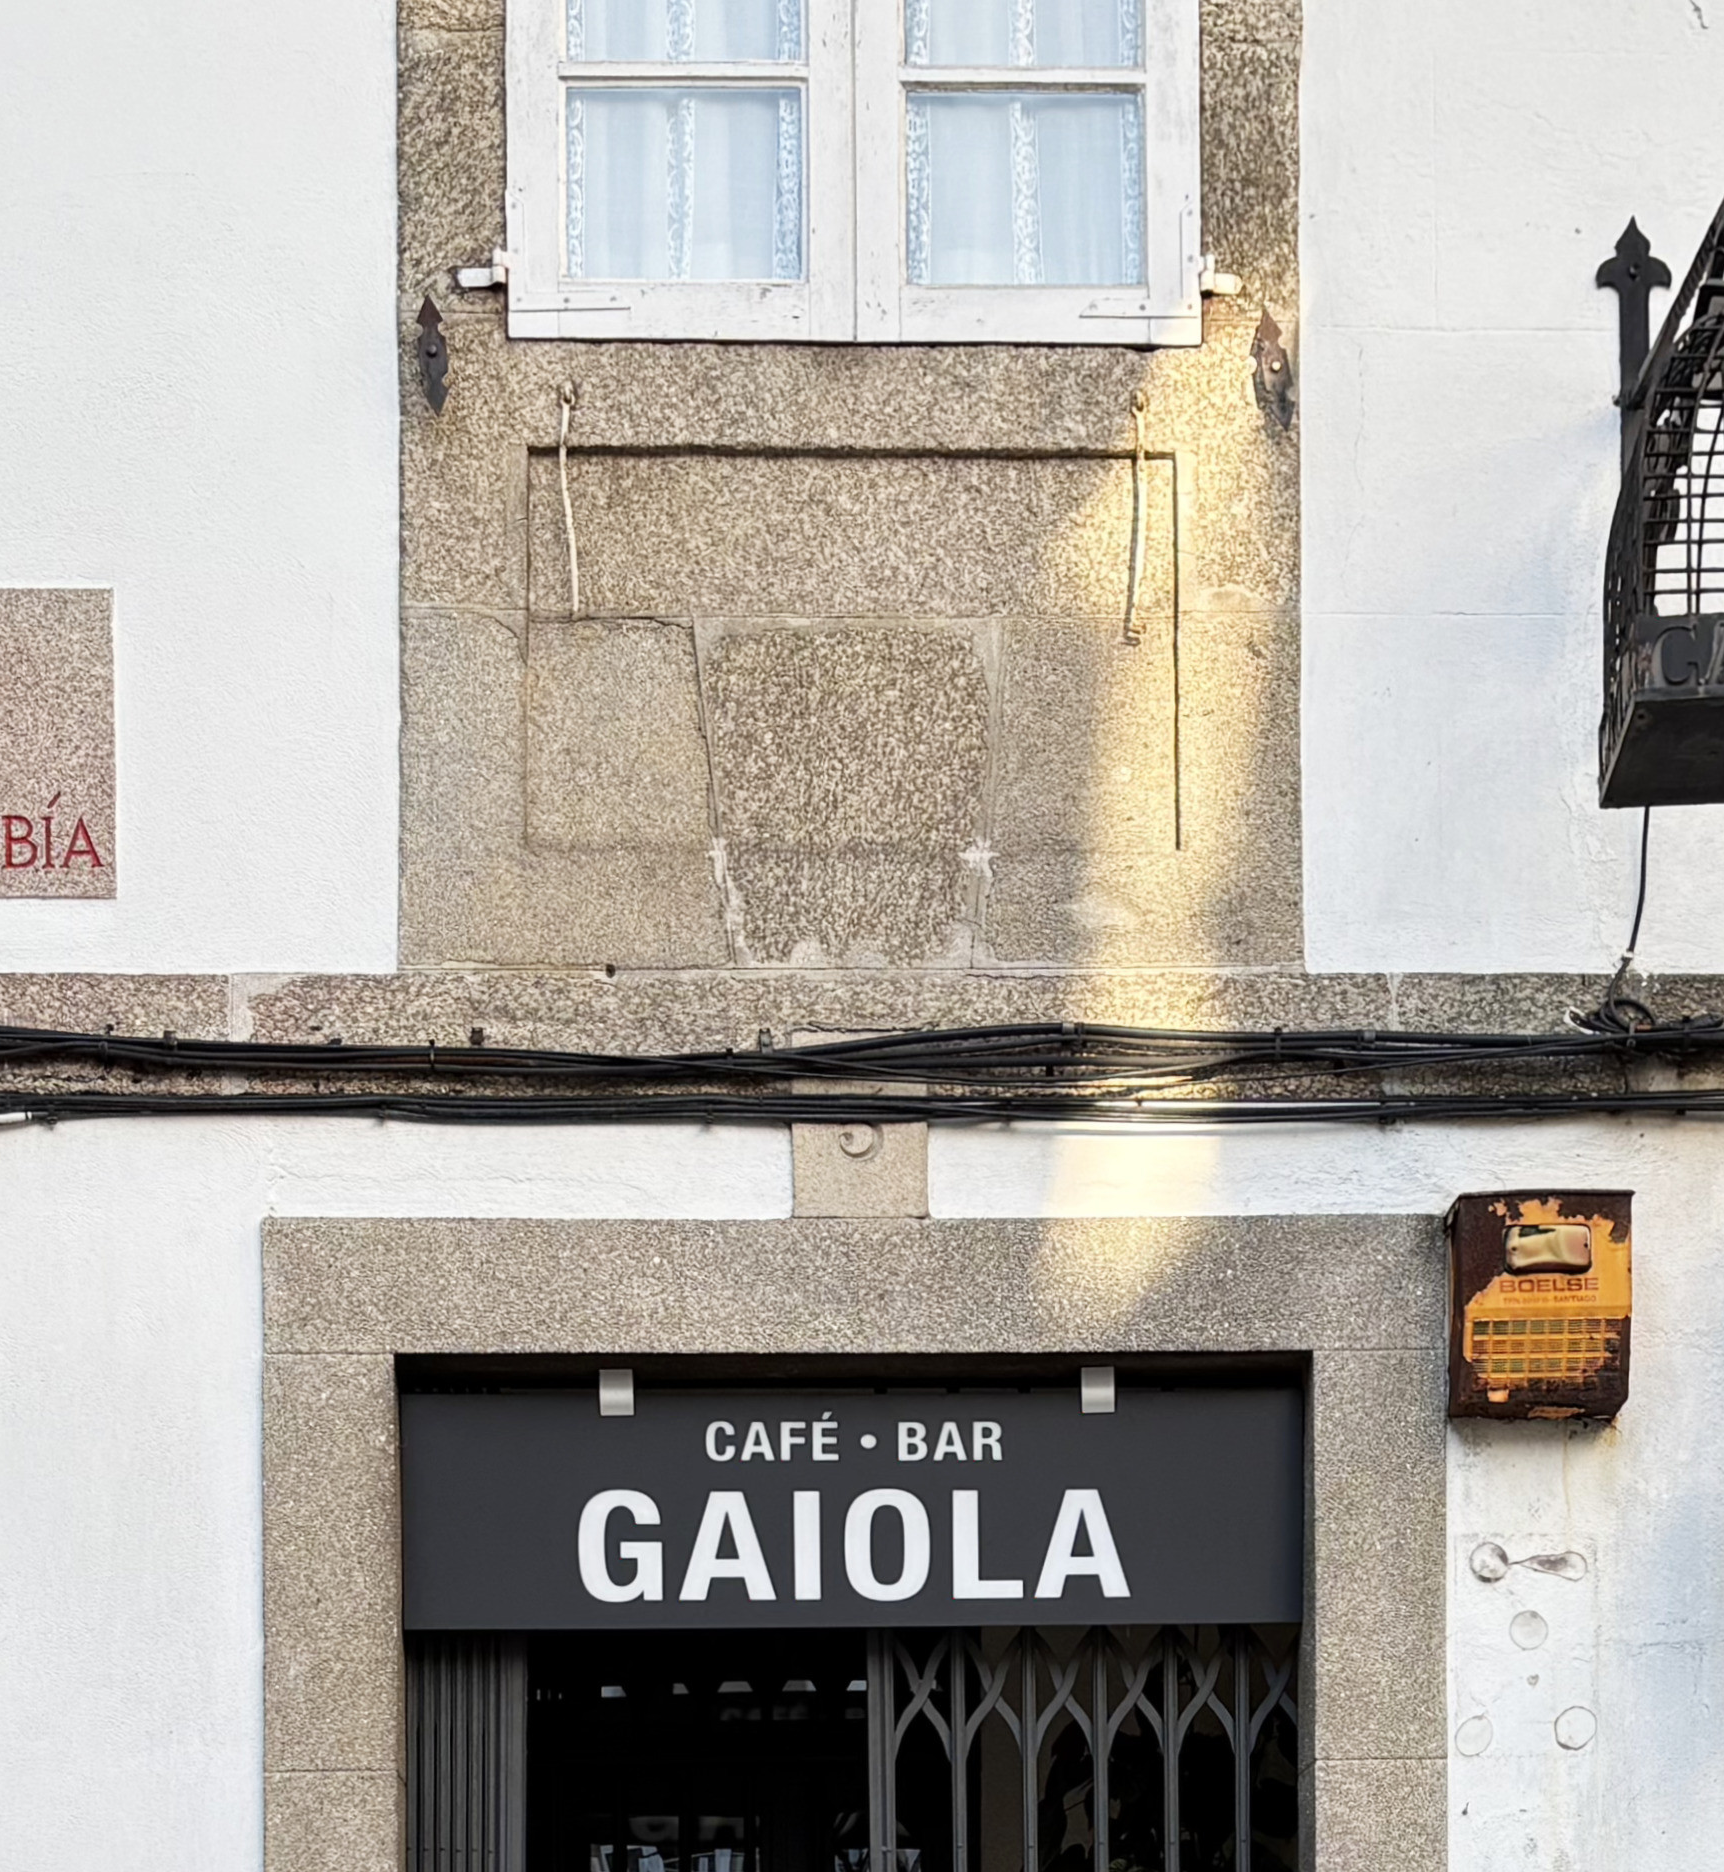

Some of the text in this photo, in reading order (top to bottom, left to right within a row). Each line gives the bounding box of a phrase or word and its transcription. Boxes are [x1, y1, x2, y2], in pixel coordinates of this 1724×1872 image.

[1499, 1277, 1600, 1293] BOELSE
[705, 1411, 1004, 1463] CAFÉ BAR
[577, 1488, 1132, 1604] GAIOLA
